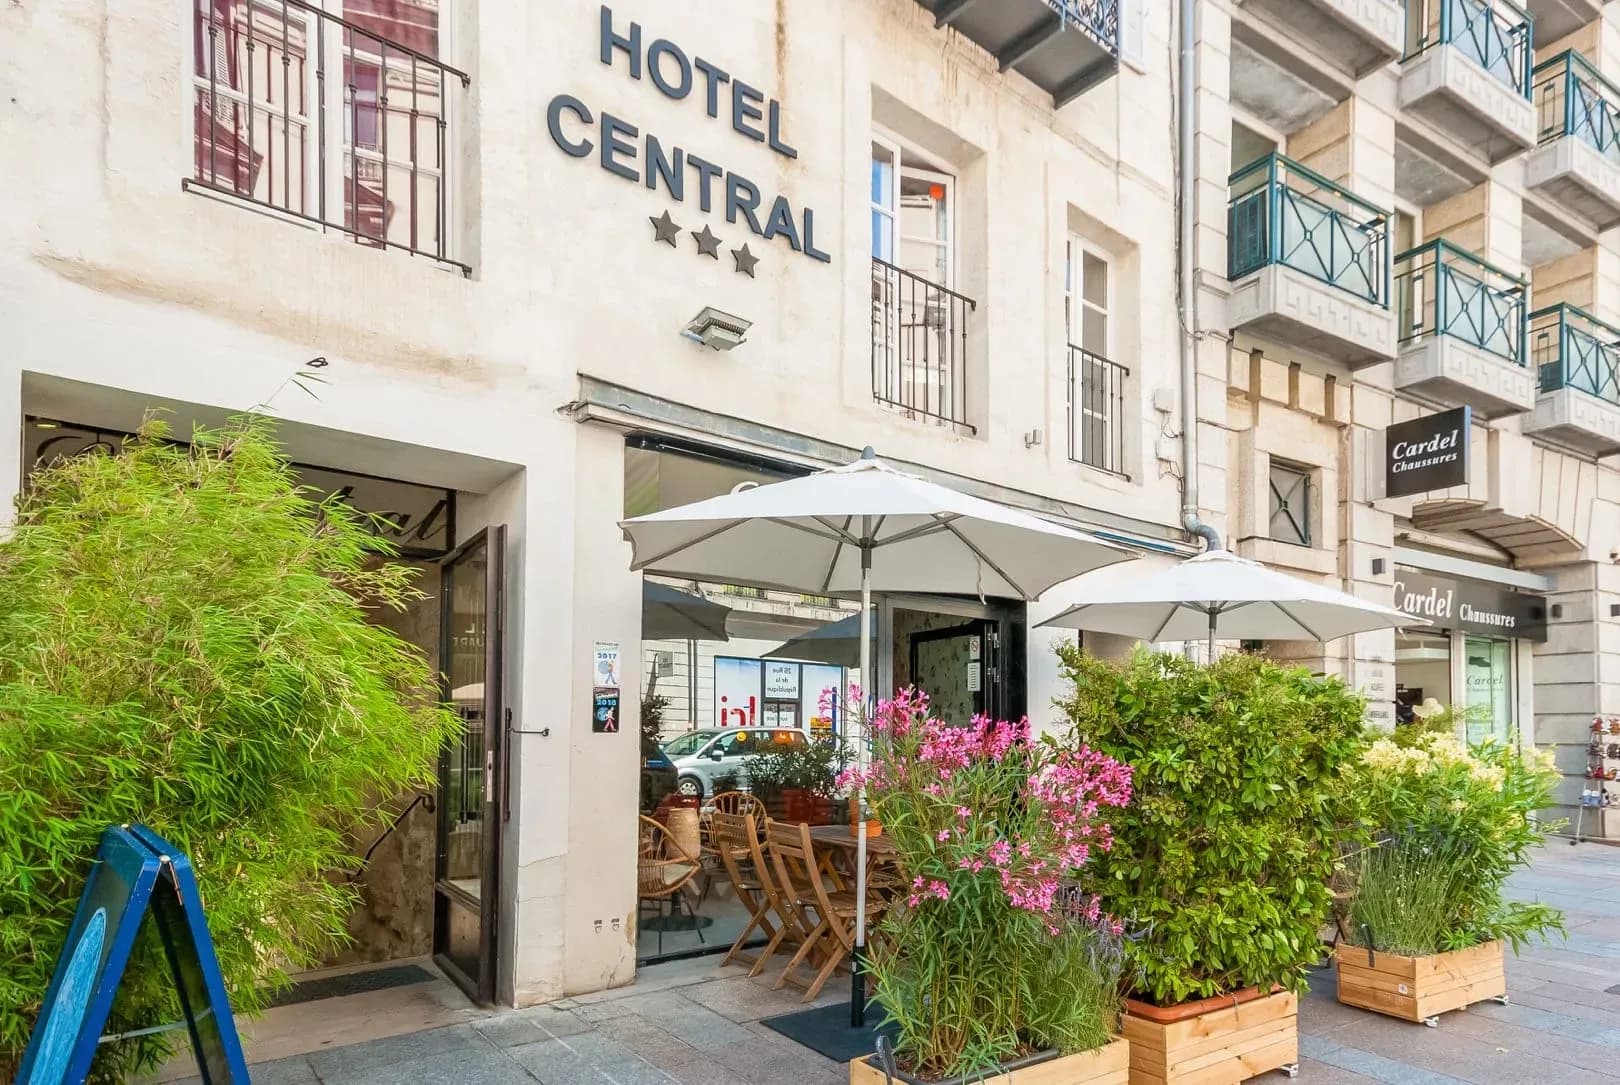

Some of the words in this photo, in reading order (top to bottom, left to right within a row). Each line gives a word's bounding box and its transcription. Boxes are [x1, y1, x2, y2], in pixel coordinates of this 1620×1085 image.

[600, 4, 798, 159] HOTEL
[547, 94, 831, 263] CENTRAL
[1392, 429, 1459, 460] Cardel
[1392, 451, 1457, 473] Chaussures
[1392, 582, 1453, 618] Cardel
[1459, 603, 1516, 628] Chaussures
[597, 652, 617, 660] 2017
